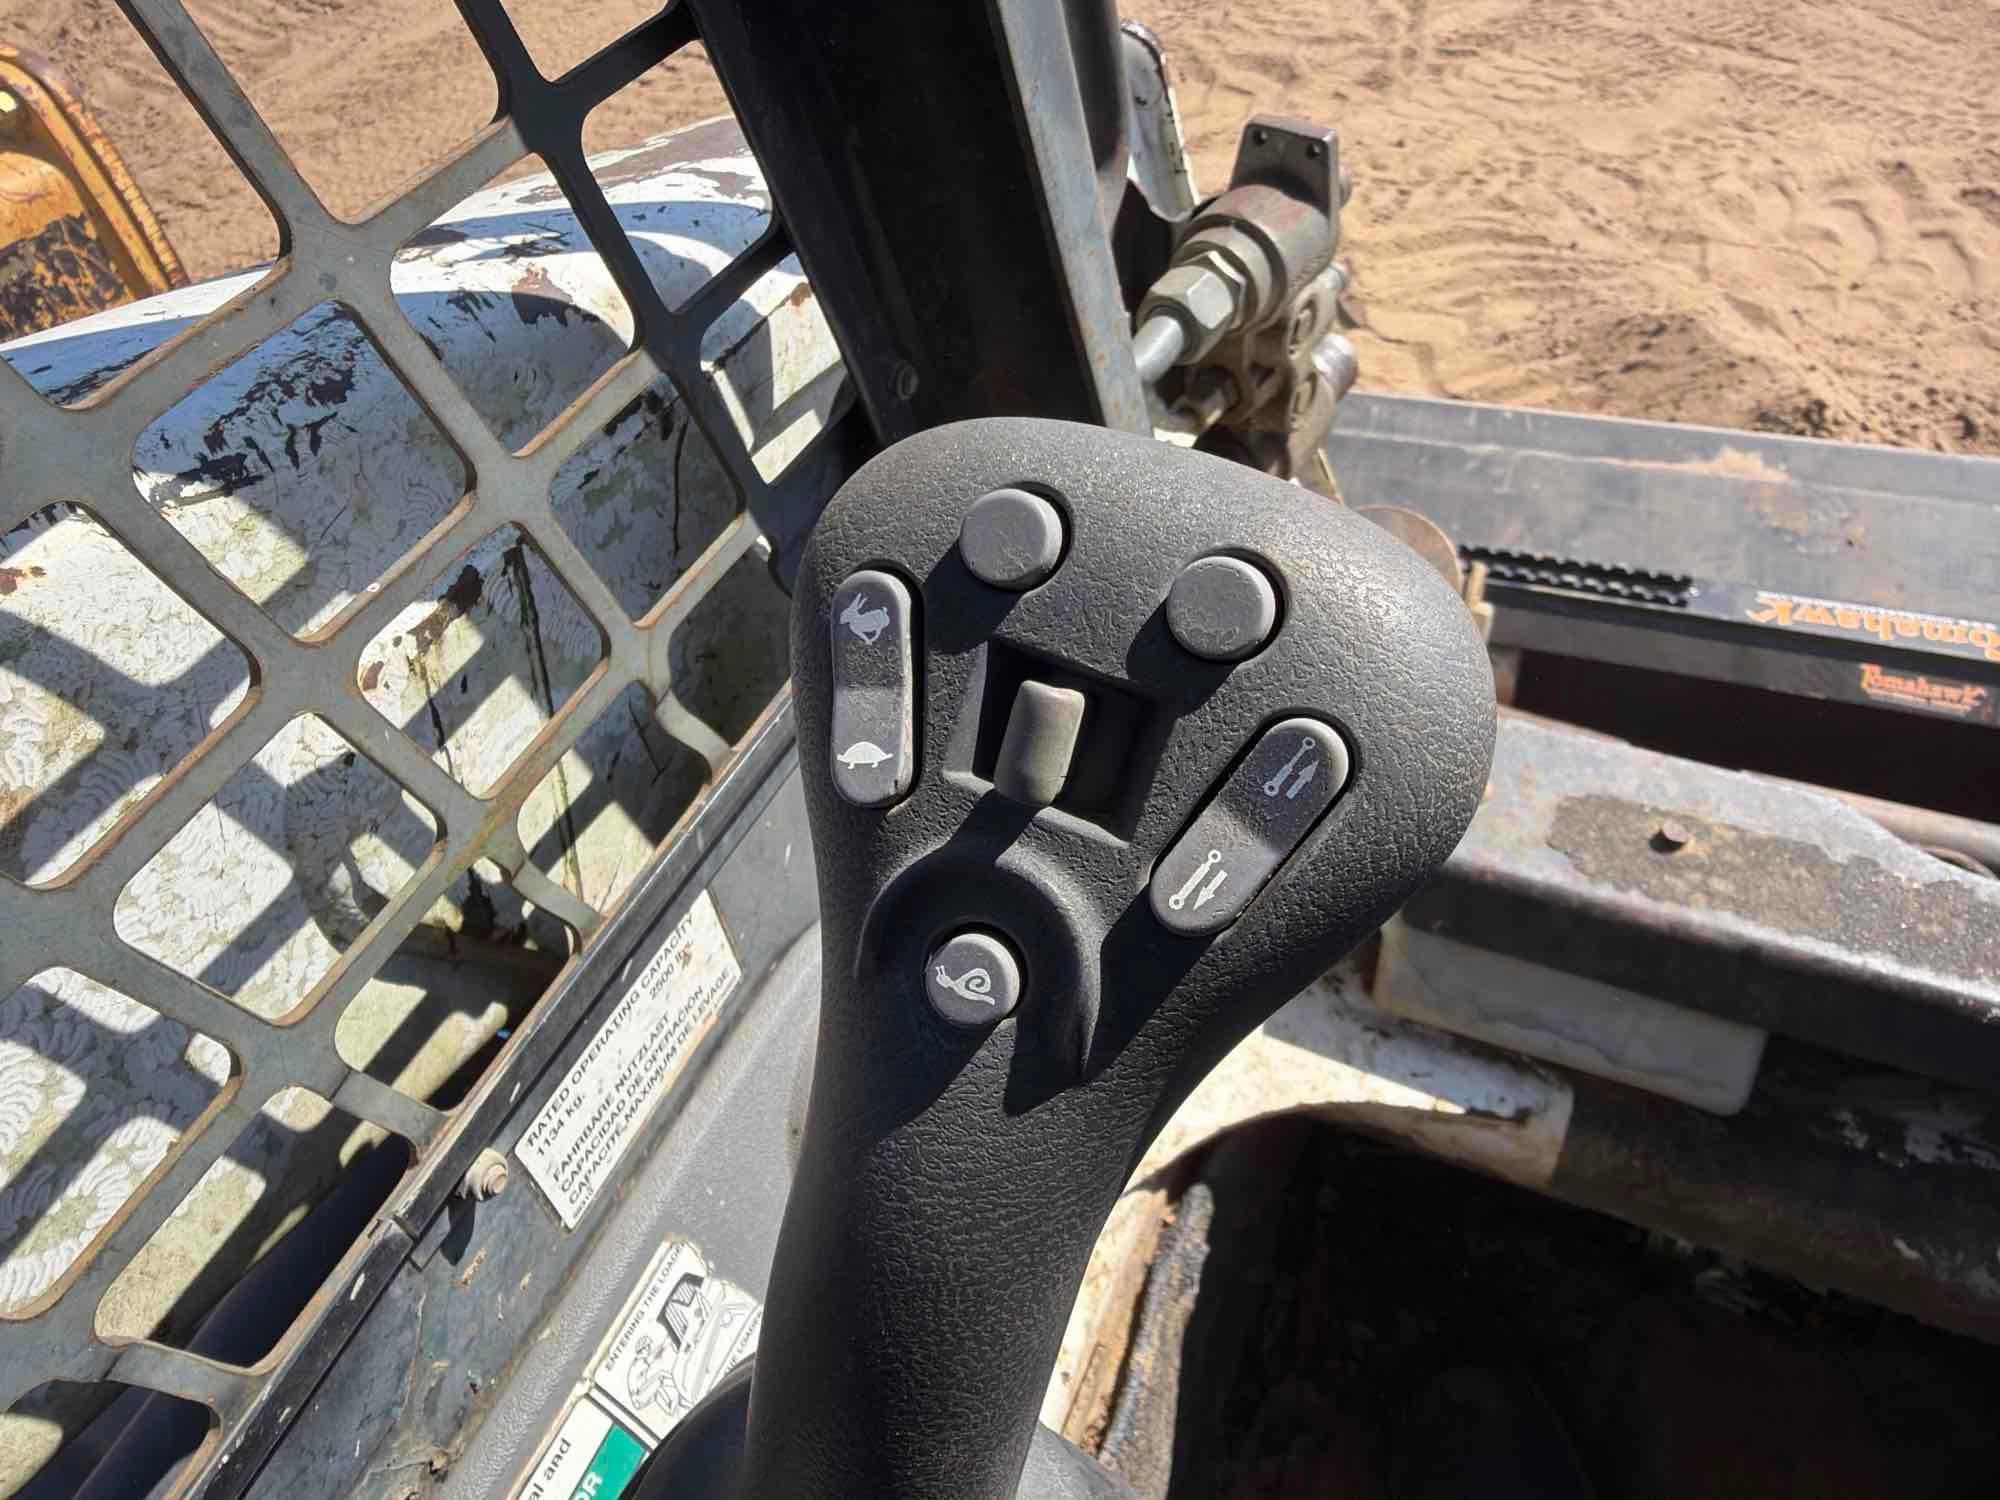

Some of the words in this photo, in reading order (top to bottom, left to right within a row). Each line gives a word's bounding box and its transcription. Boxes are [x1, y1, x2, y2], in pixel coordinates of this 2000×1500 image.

[527, 1086, 570, 1147] RATED
[571, 990, 641, 1085] OPERATING
[641, 913, 692, 990] CAPACITY
[650, 964, 675, 1000] 2500
[553, 1092, 613, 1182] FAHRBARE
[615, 1010, 670, 1093] NUTZLAST
[624, 1045, 677, 1123] MAXIMUM
[692, 967, 729, 1022] LEVAGE
[537, 1119, 564, 1156] 1134
[561, 1099, 625, 1193] CAPACIDAD
[626, 1074, 643, 1097] DE
[605, 1310, 645, 1371] ENTERING
[643, 1286, 659, 1312] THE
[544, 1437, 571, 1480] and
